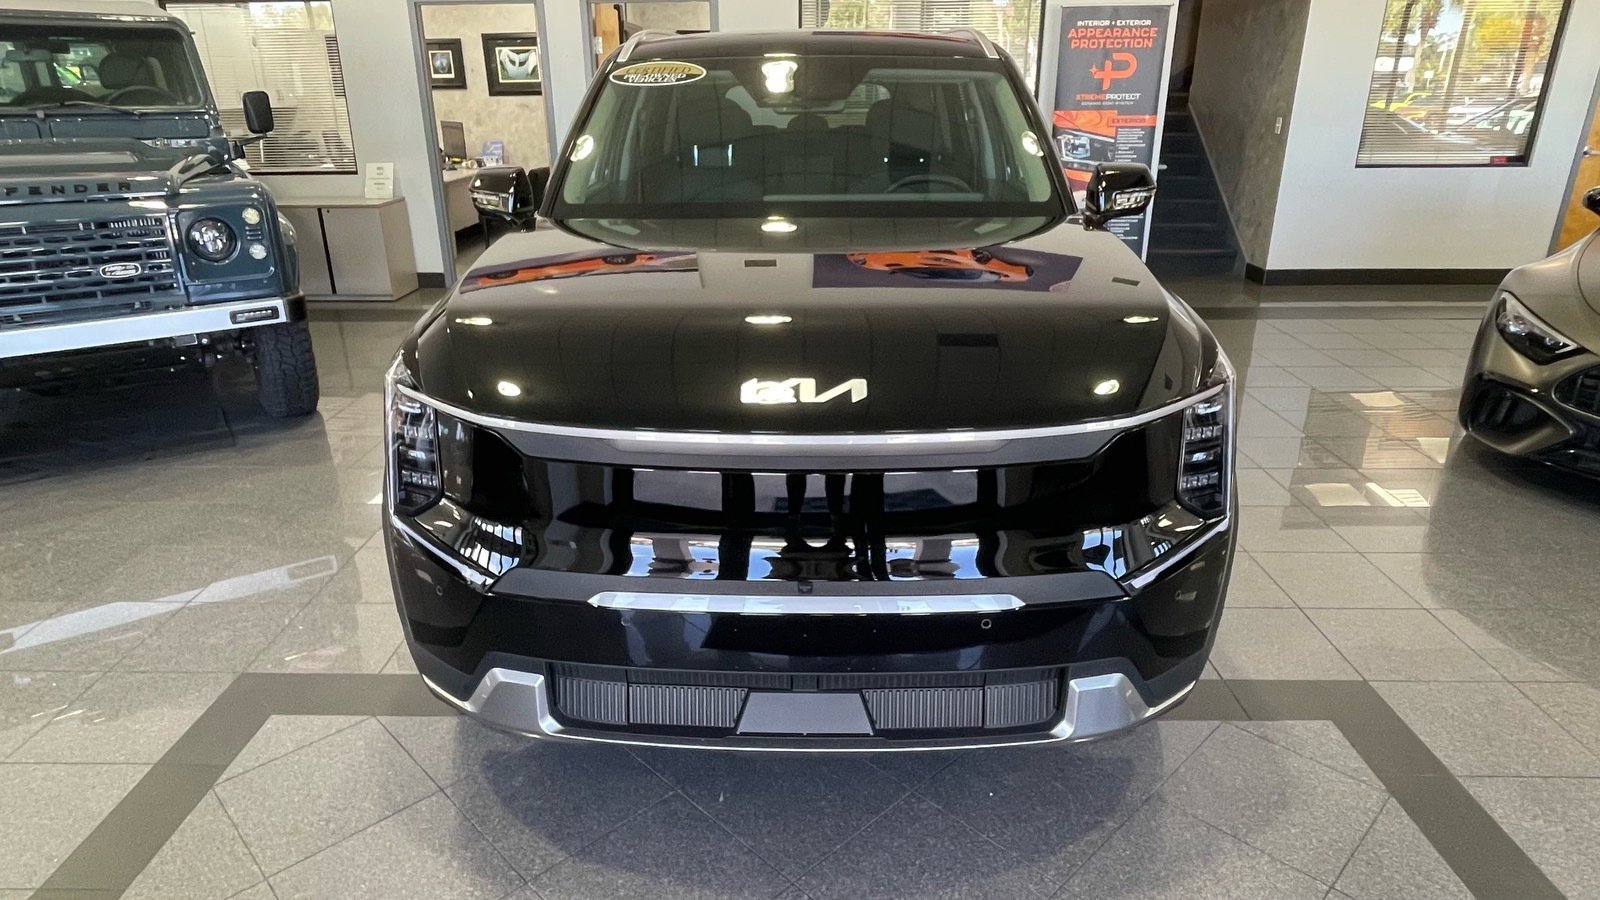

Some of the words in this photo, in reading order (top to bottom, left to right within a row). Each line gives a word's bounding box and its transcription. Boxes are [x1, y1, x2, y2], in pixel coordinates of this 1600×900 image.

[1068, 28, 1158, 38] APPEARANCE
[1071, 38, 1153, 48] PROTECTION
[4, 182, 132, 197] FENDER
